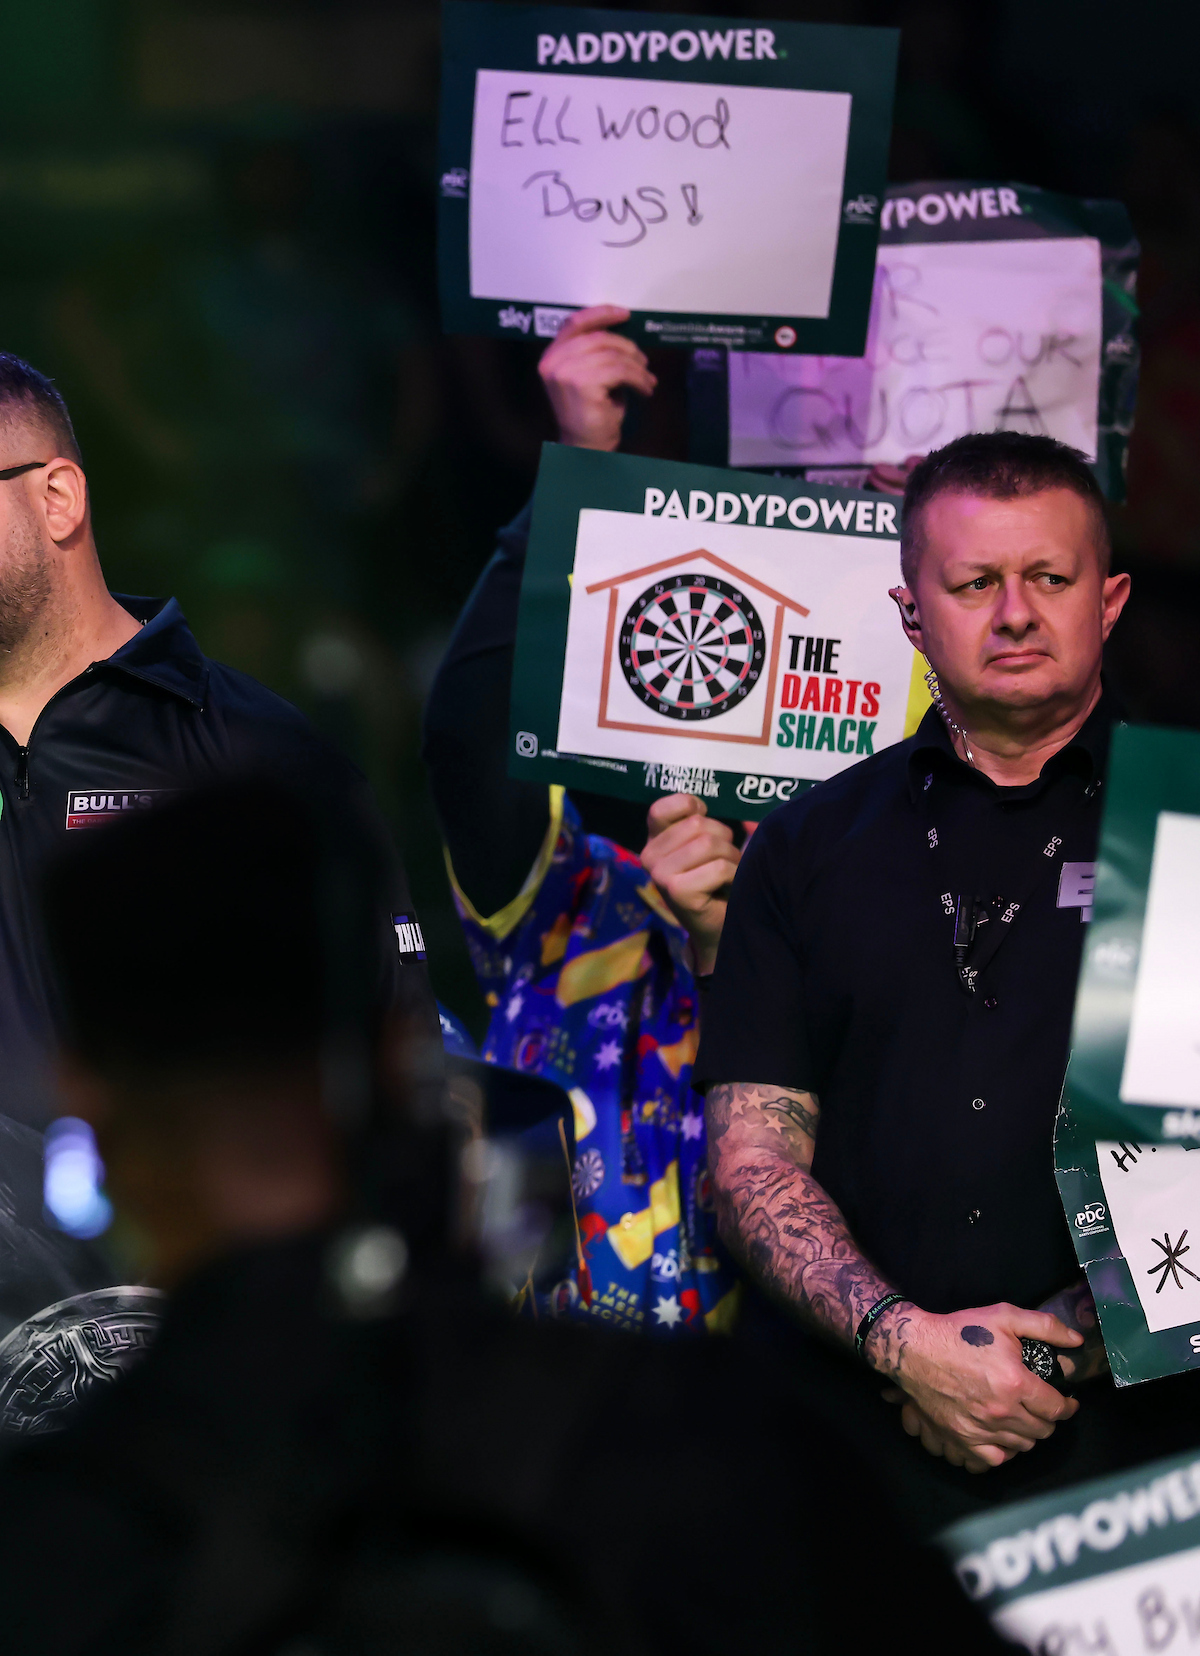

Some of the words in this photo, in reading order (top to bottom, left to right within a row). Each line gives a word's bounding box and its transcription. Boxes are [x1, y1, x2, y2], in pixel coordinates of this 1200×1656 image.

[787, 634, 842, 674] THE
[780, 674, 882, 718] DARTS
[776, 713, 879, 756] SHACK
[659, 776, 703, 796] CANCER
[704, 781, 720, 798] UK
[741, 774, 794, 800] PDC
[73, 794, 154, 812] BULL'S
[927, 827, 939, 849] EPS
[1042, 835, 1063, 858] EPS
[940, 891, 955, 916] EPS
[1000, 902, 1021, 924] EPS
[1076, 1207, 1106, 1226] PDC
